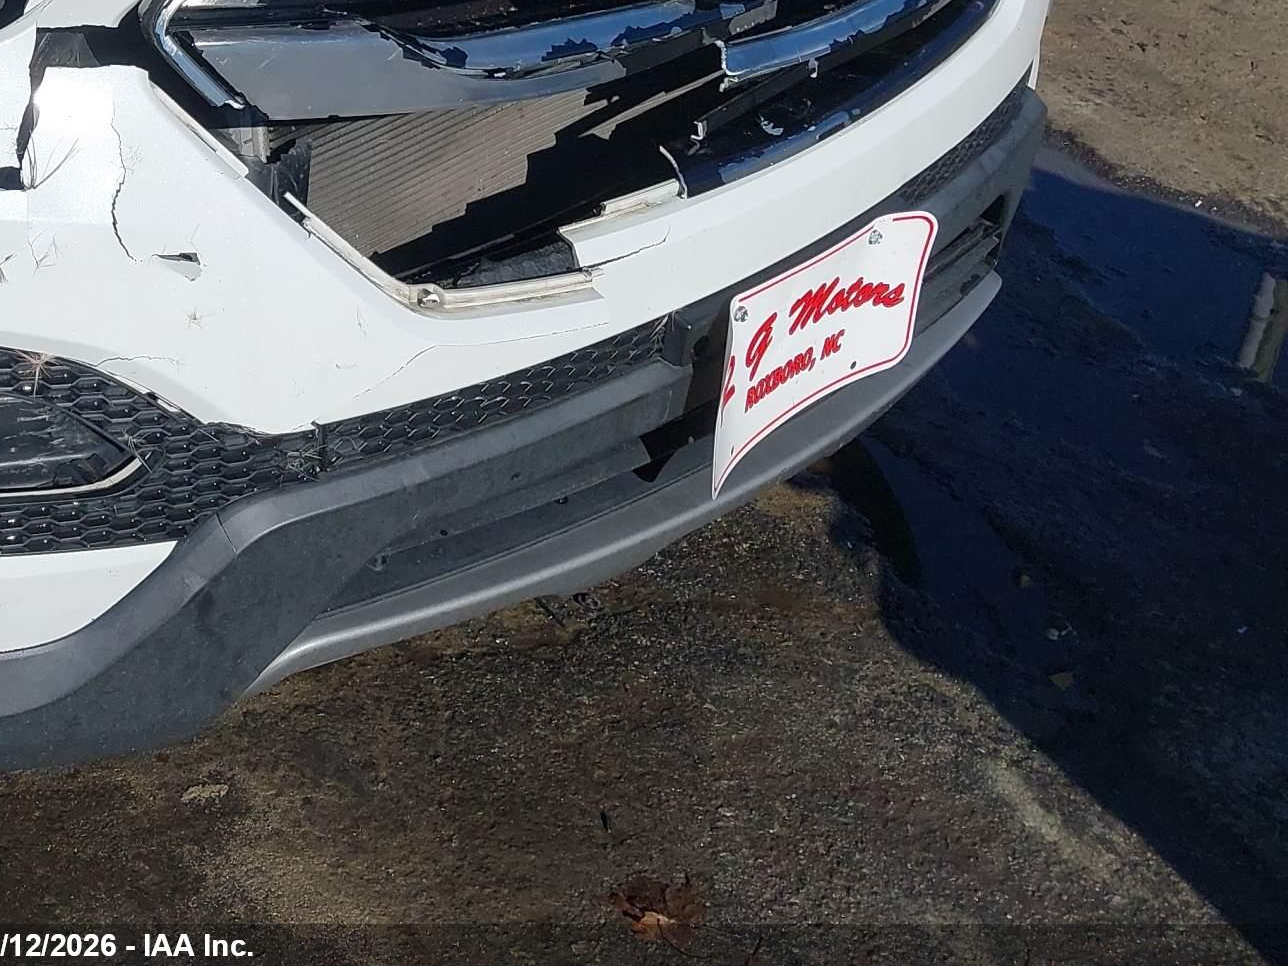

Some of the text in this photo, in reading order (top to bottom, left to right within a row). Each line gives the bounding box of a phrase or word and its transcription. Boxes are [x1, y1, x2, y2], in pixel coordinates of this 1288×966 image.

[788, 276, 906, 336] Motors
[744, 346, 816, 414] ROXBORO,
[819, 328, 846, 361] NC
